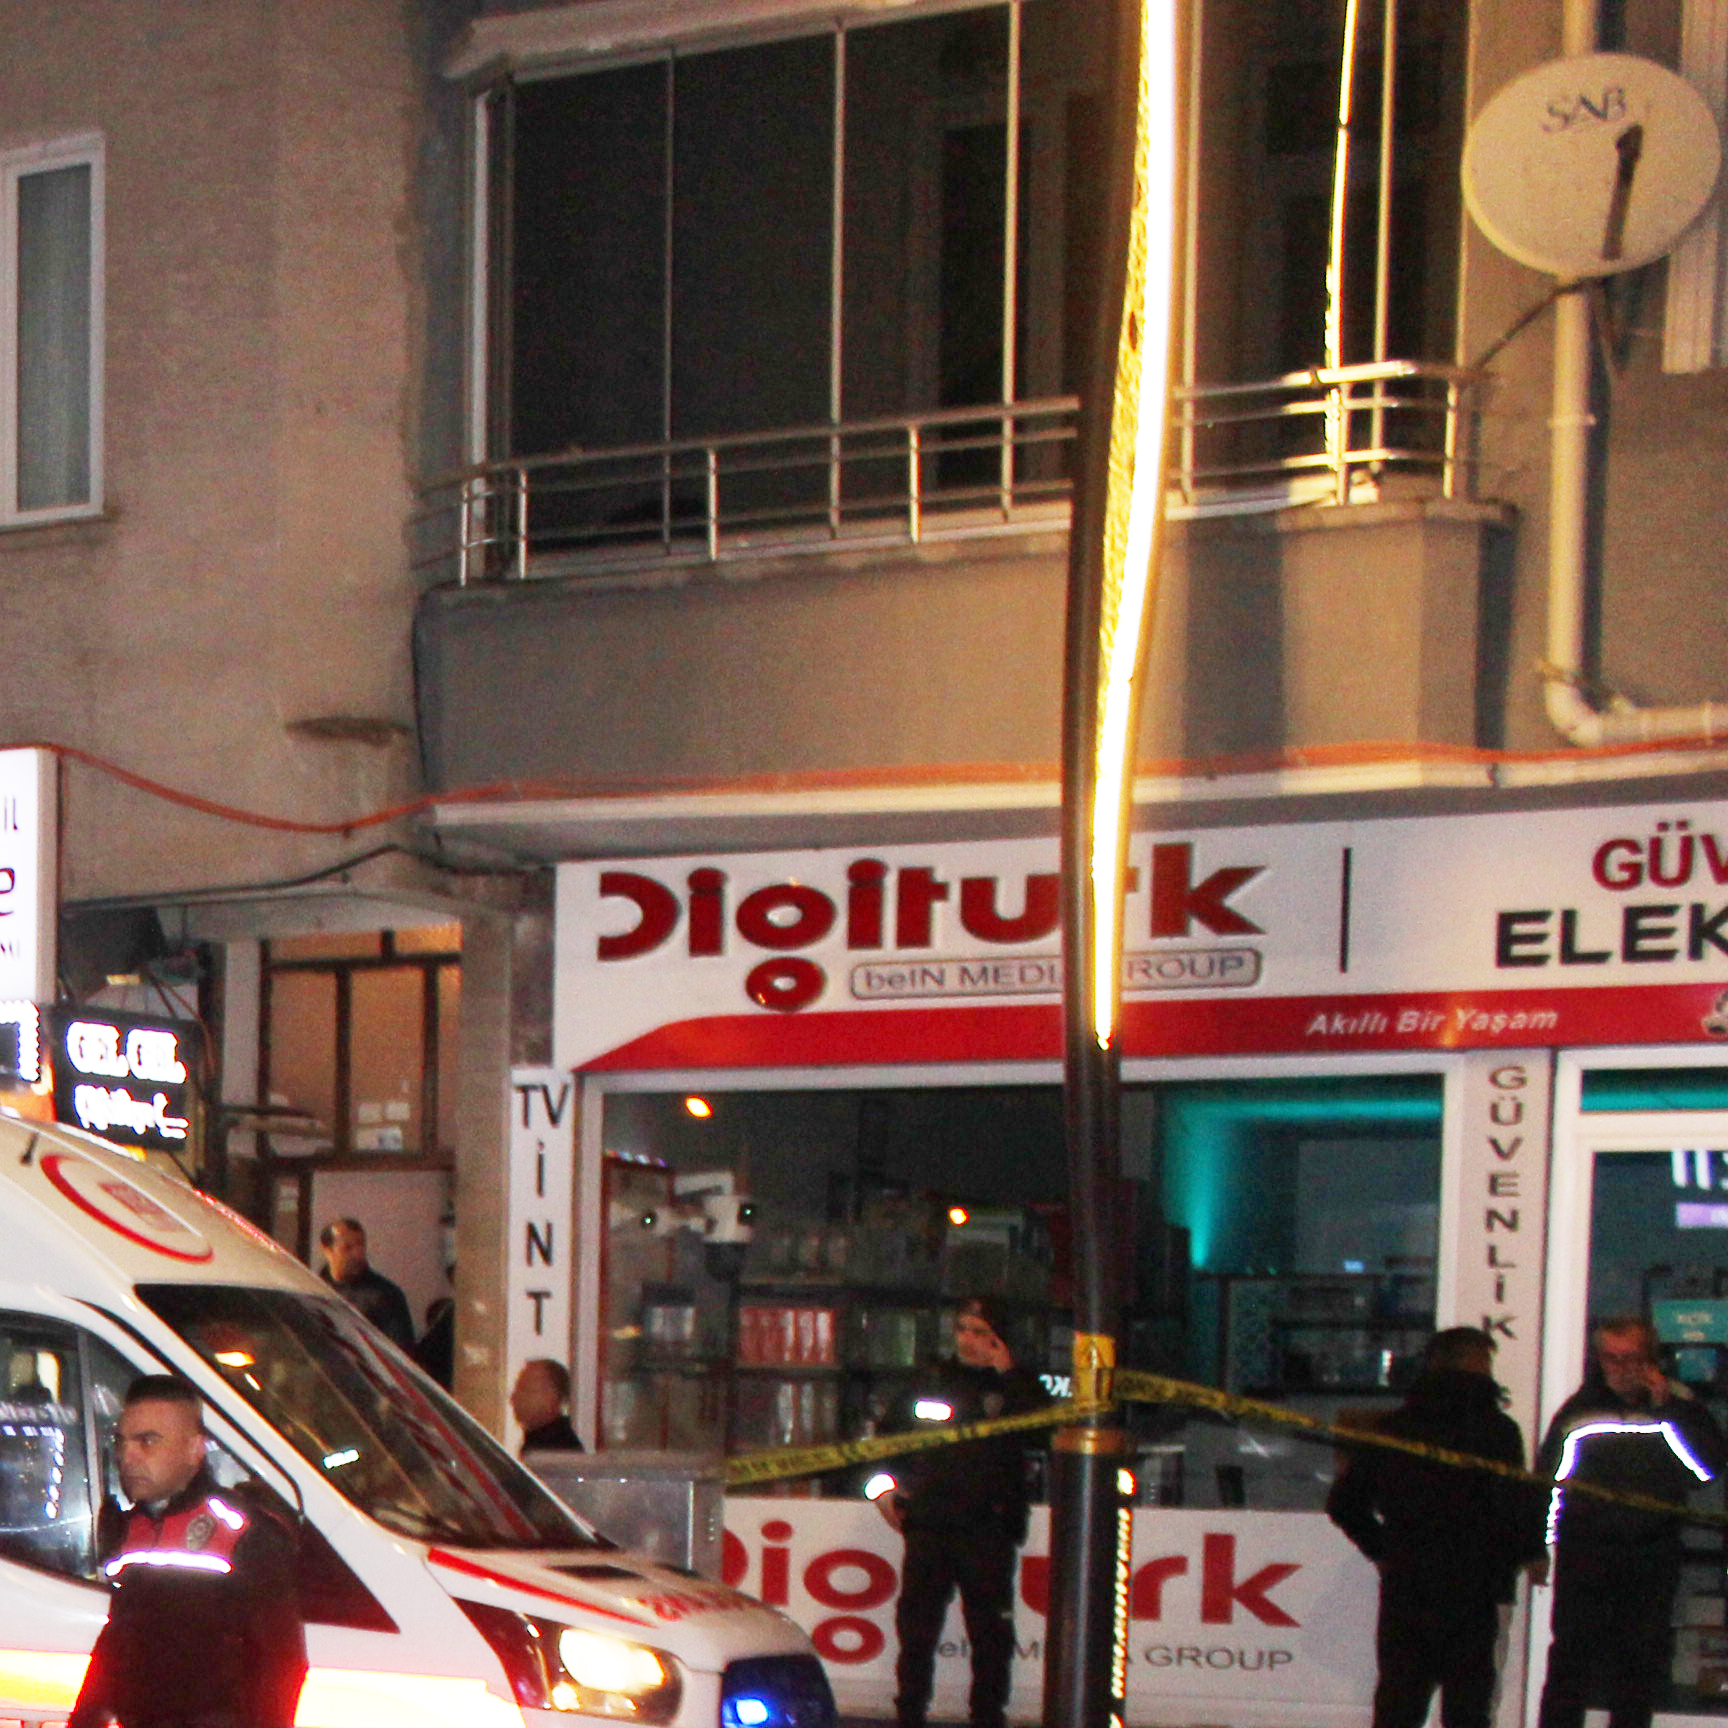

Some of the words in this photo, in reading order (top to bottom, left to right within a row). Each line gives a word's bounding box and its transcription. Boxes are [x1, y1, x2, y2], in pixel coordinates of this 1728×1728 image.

[597, 841, 1268, 1012] Digituk
[1496, 902, 1728, 968] ELEK
[959, 959, 1061, 987] MEDI
[1128, 955, 1245, 980] ROUP
[1396, 1010, 1446, 1034] Bir
[1455, 1008, 1558, 1036] Yaşam
[512, 1084, 570, 1129] TV
[1146, 1645, 1294, 1671] GROUP
